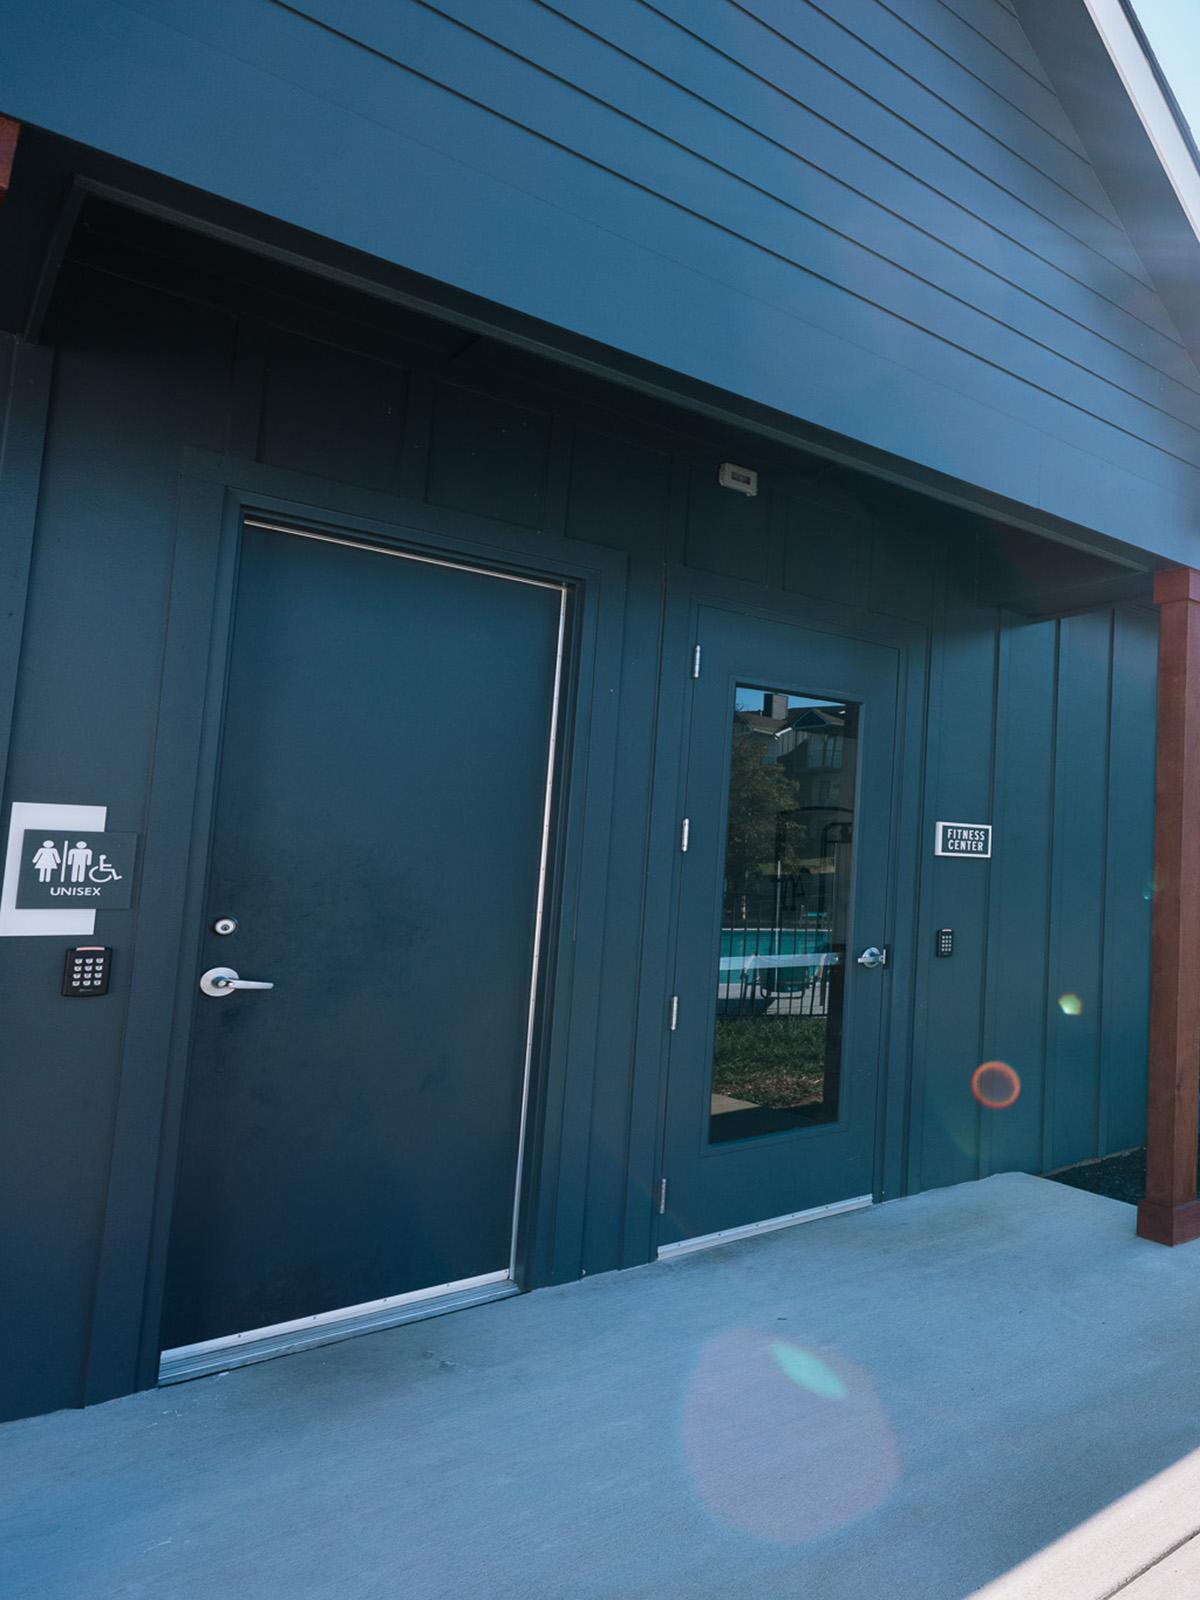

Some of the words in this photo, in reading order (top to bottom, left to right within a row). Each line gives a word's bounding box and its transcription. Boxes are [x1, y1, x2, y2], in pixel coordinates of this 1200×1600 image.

[947, 828, 985, 841] FITNESS
[948, 839, 984, 851] CENTER
[50, 887, 101, 896] UNISEX
